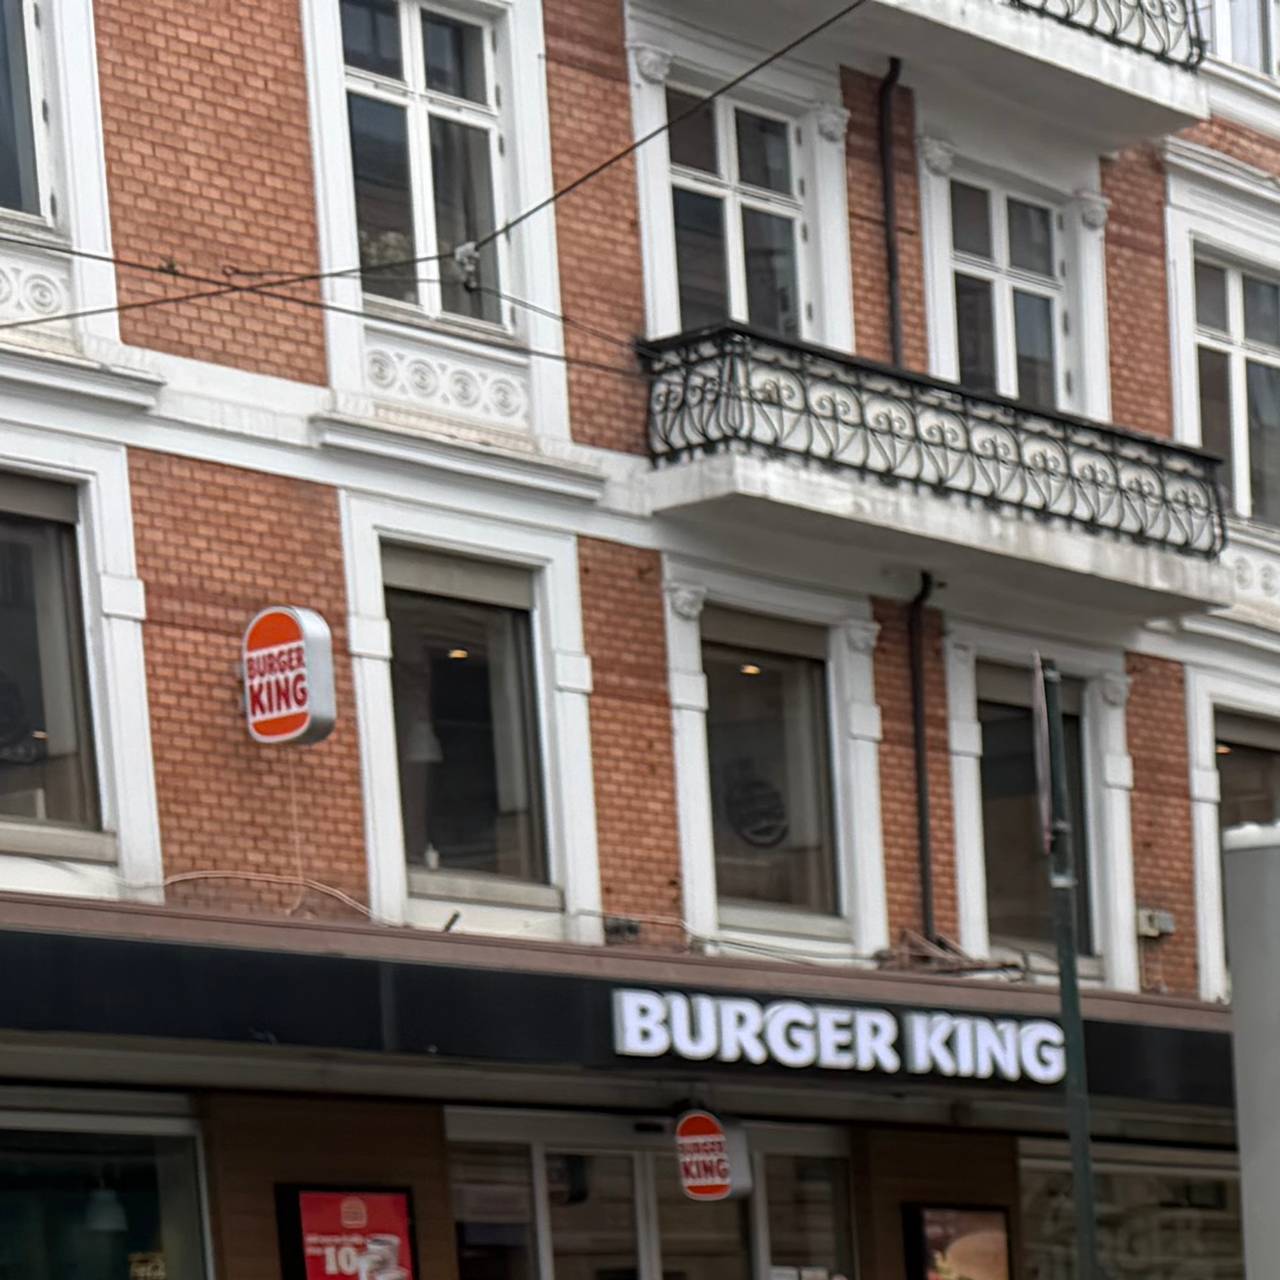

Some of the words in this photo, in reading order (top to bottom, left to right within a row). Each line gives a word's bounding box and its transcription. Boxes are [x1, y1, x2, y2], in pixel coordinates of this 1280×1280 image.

[247, 646, 305, 679] BURGER
[249, 674, 308, 717] KING
[613, 987, 901, 1074] BURGER
[906, 1010, 1067, 1084] KING
[681, 1158, 730, 1180] KING
